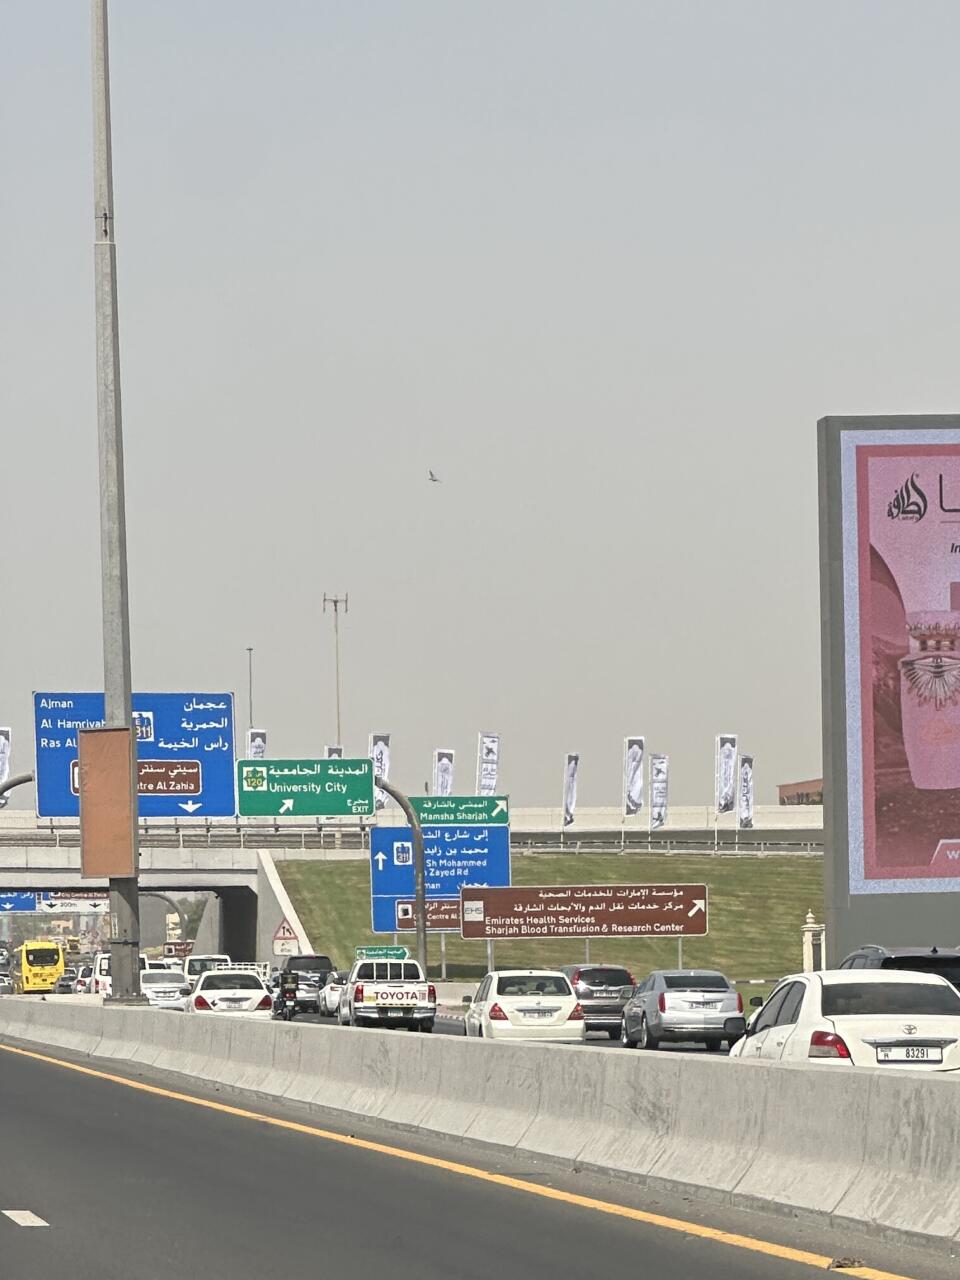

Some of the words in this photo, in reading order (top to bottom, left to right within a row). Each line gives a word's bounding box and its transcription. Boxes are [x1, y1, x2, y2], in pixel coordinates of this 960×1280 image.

[40, 698, 74, 709] Ajman
[183, 698, 227, 712] عجمان
[41, 718, 52, 729] Al
[181, 717, 228, 731] الحمرية
[40, 737, 61, 748] Ras
[65, 737, 77, 748] Al
[158, 737, 199, 751] الخيمة
[204, 735, 229, 751] رأس
[139, 764, 166, 775] سنتر
[168, 764, 198, 778] سيتي
[268, 763, 321, 776] الجامعية
[327, 763, 368, 778] المدينة
[156, 782, 167, 790] Al
[169, 782, 195, 790] Zahia
[269, 782, 321, 794] University
[325, 782, 348, 794] City
[352, 805, 369, 814] EXIT
[420, 812, 455, 820] Mamsha
[457, 811, 488, 821] Sharjah
[444, 829, 470, 842] شارع
[473, 829, 489, 842] إلى
[445, 848, 458, 856] بن
[460, 847, 489, 855] محمد
[426, 859, 437, 867] Sh
[439, 859, 488, 867] Mohammed
[429, 868, 456, 877] Zayed
[456, 868, 469, 876] Rd
[538, 889, 571, 899] الصحية
[574, 889, 613, 897] للخدمات
[651, 888, 684, 898] مؤسسة
[513, 903, 544, 913] الشارقة
[588, 902, 606, 913] الدم
[608, 902, 625, 912] نقل
[628, 902, 660, 910] خدمات
[662, 901, 684, 910] مركز
[485, 916, 524, 925] Emirates
[526, 916, 556, 924] Health
[558, 915, 596, 924] Services
[485, 925, 519, 935] Sharjah
[521, 925, 547, 934] Blood
[550, 924, 600, 933] Transfusion
[601, 924, 608, 932] &
[611, 923, 651, 932] Research
[653, 922, 684, 932] Center
[374, 991, 418, 1000] TOYOTA
[905, 1047, 929, 1059] 83291
